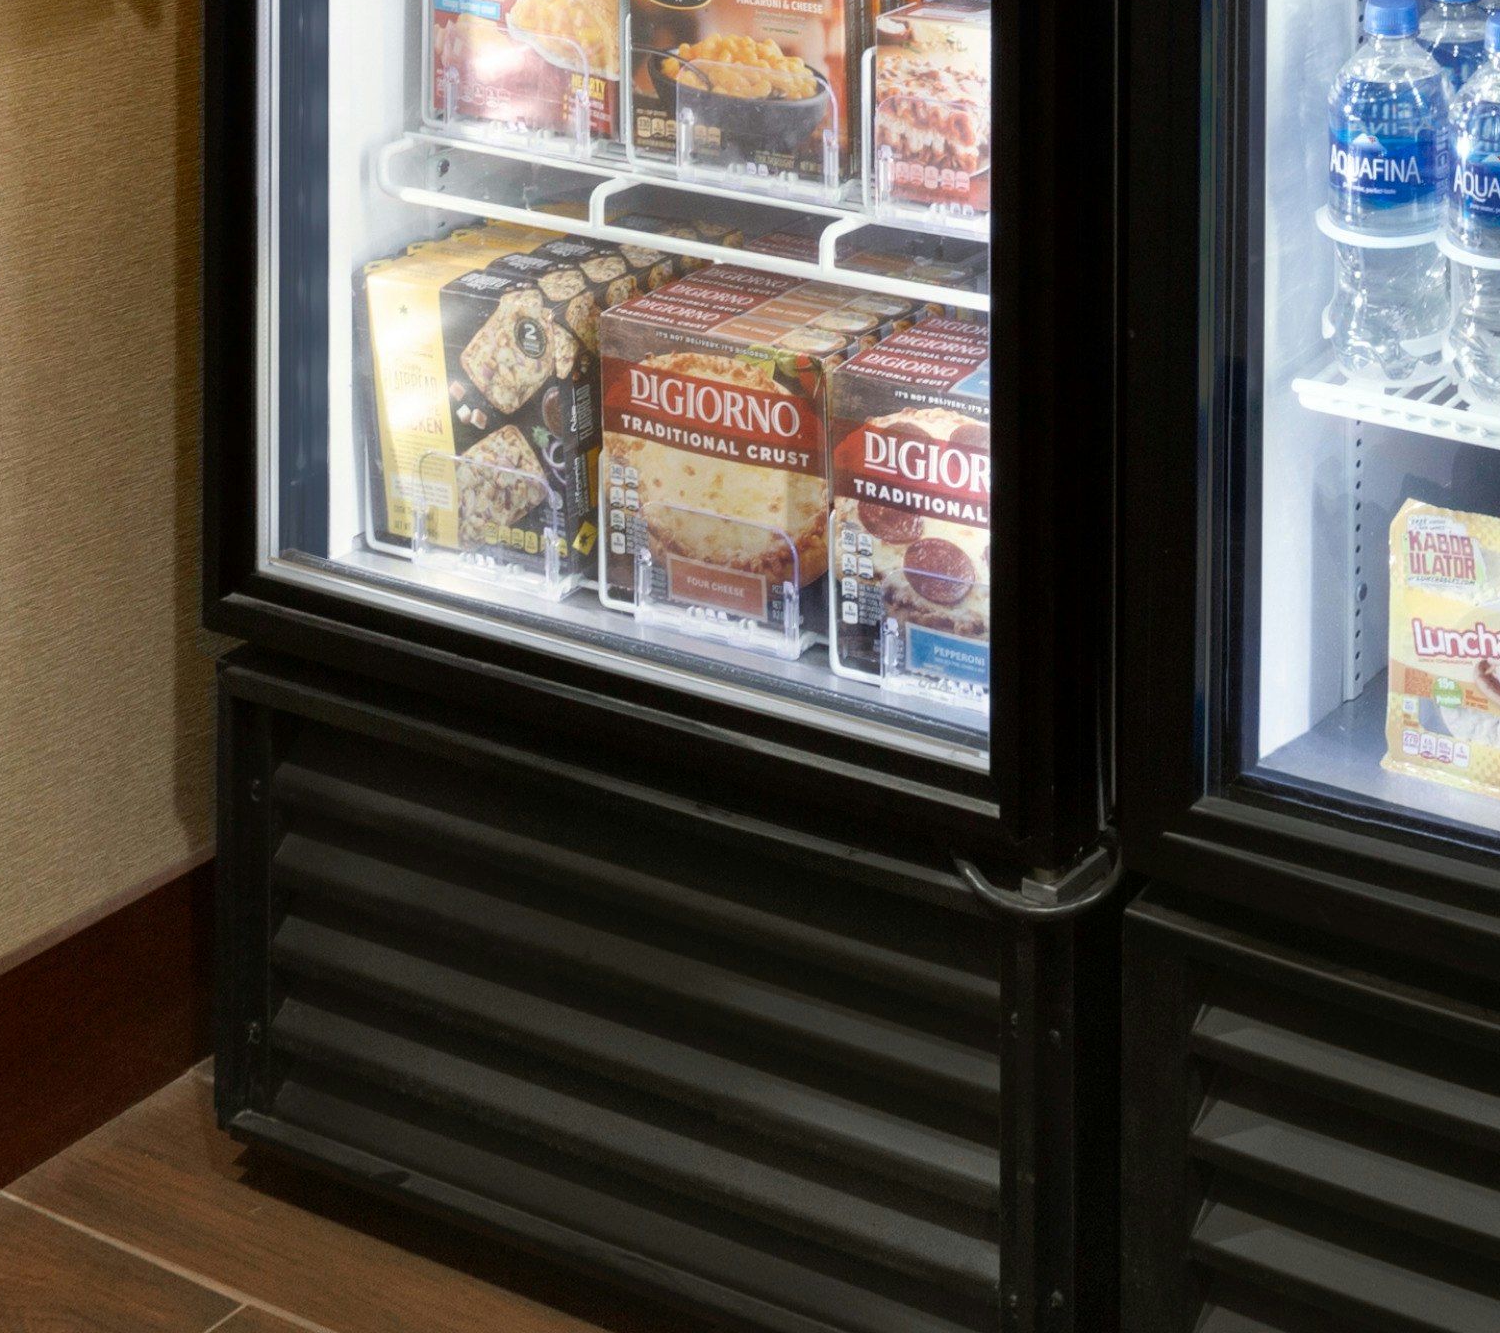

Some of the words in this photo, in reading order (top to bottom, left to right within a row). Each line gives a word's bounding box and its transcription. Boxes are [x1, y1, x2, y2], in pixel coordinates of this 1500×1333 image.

[792, 1, 823, 14] CHEESE
[1330, 145, 1422, 183] AQUAFINA
[525, 324, 537, 340] 2
[630, 368, 800, 437] DIGIORNO
[621, 414, 739, 456] TRADITIONAL
[747, 444, 810, 468] CRUST
[854, 479, 987, 522] TRADITIONAL
[1409, 531, 1475, 557] KABOB
[1410, 552, 1476, 580] ULATOR
[934, 645, 985, 665] PEPPERONI
